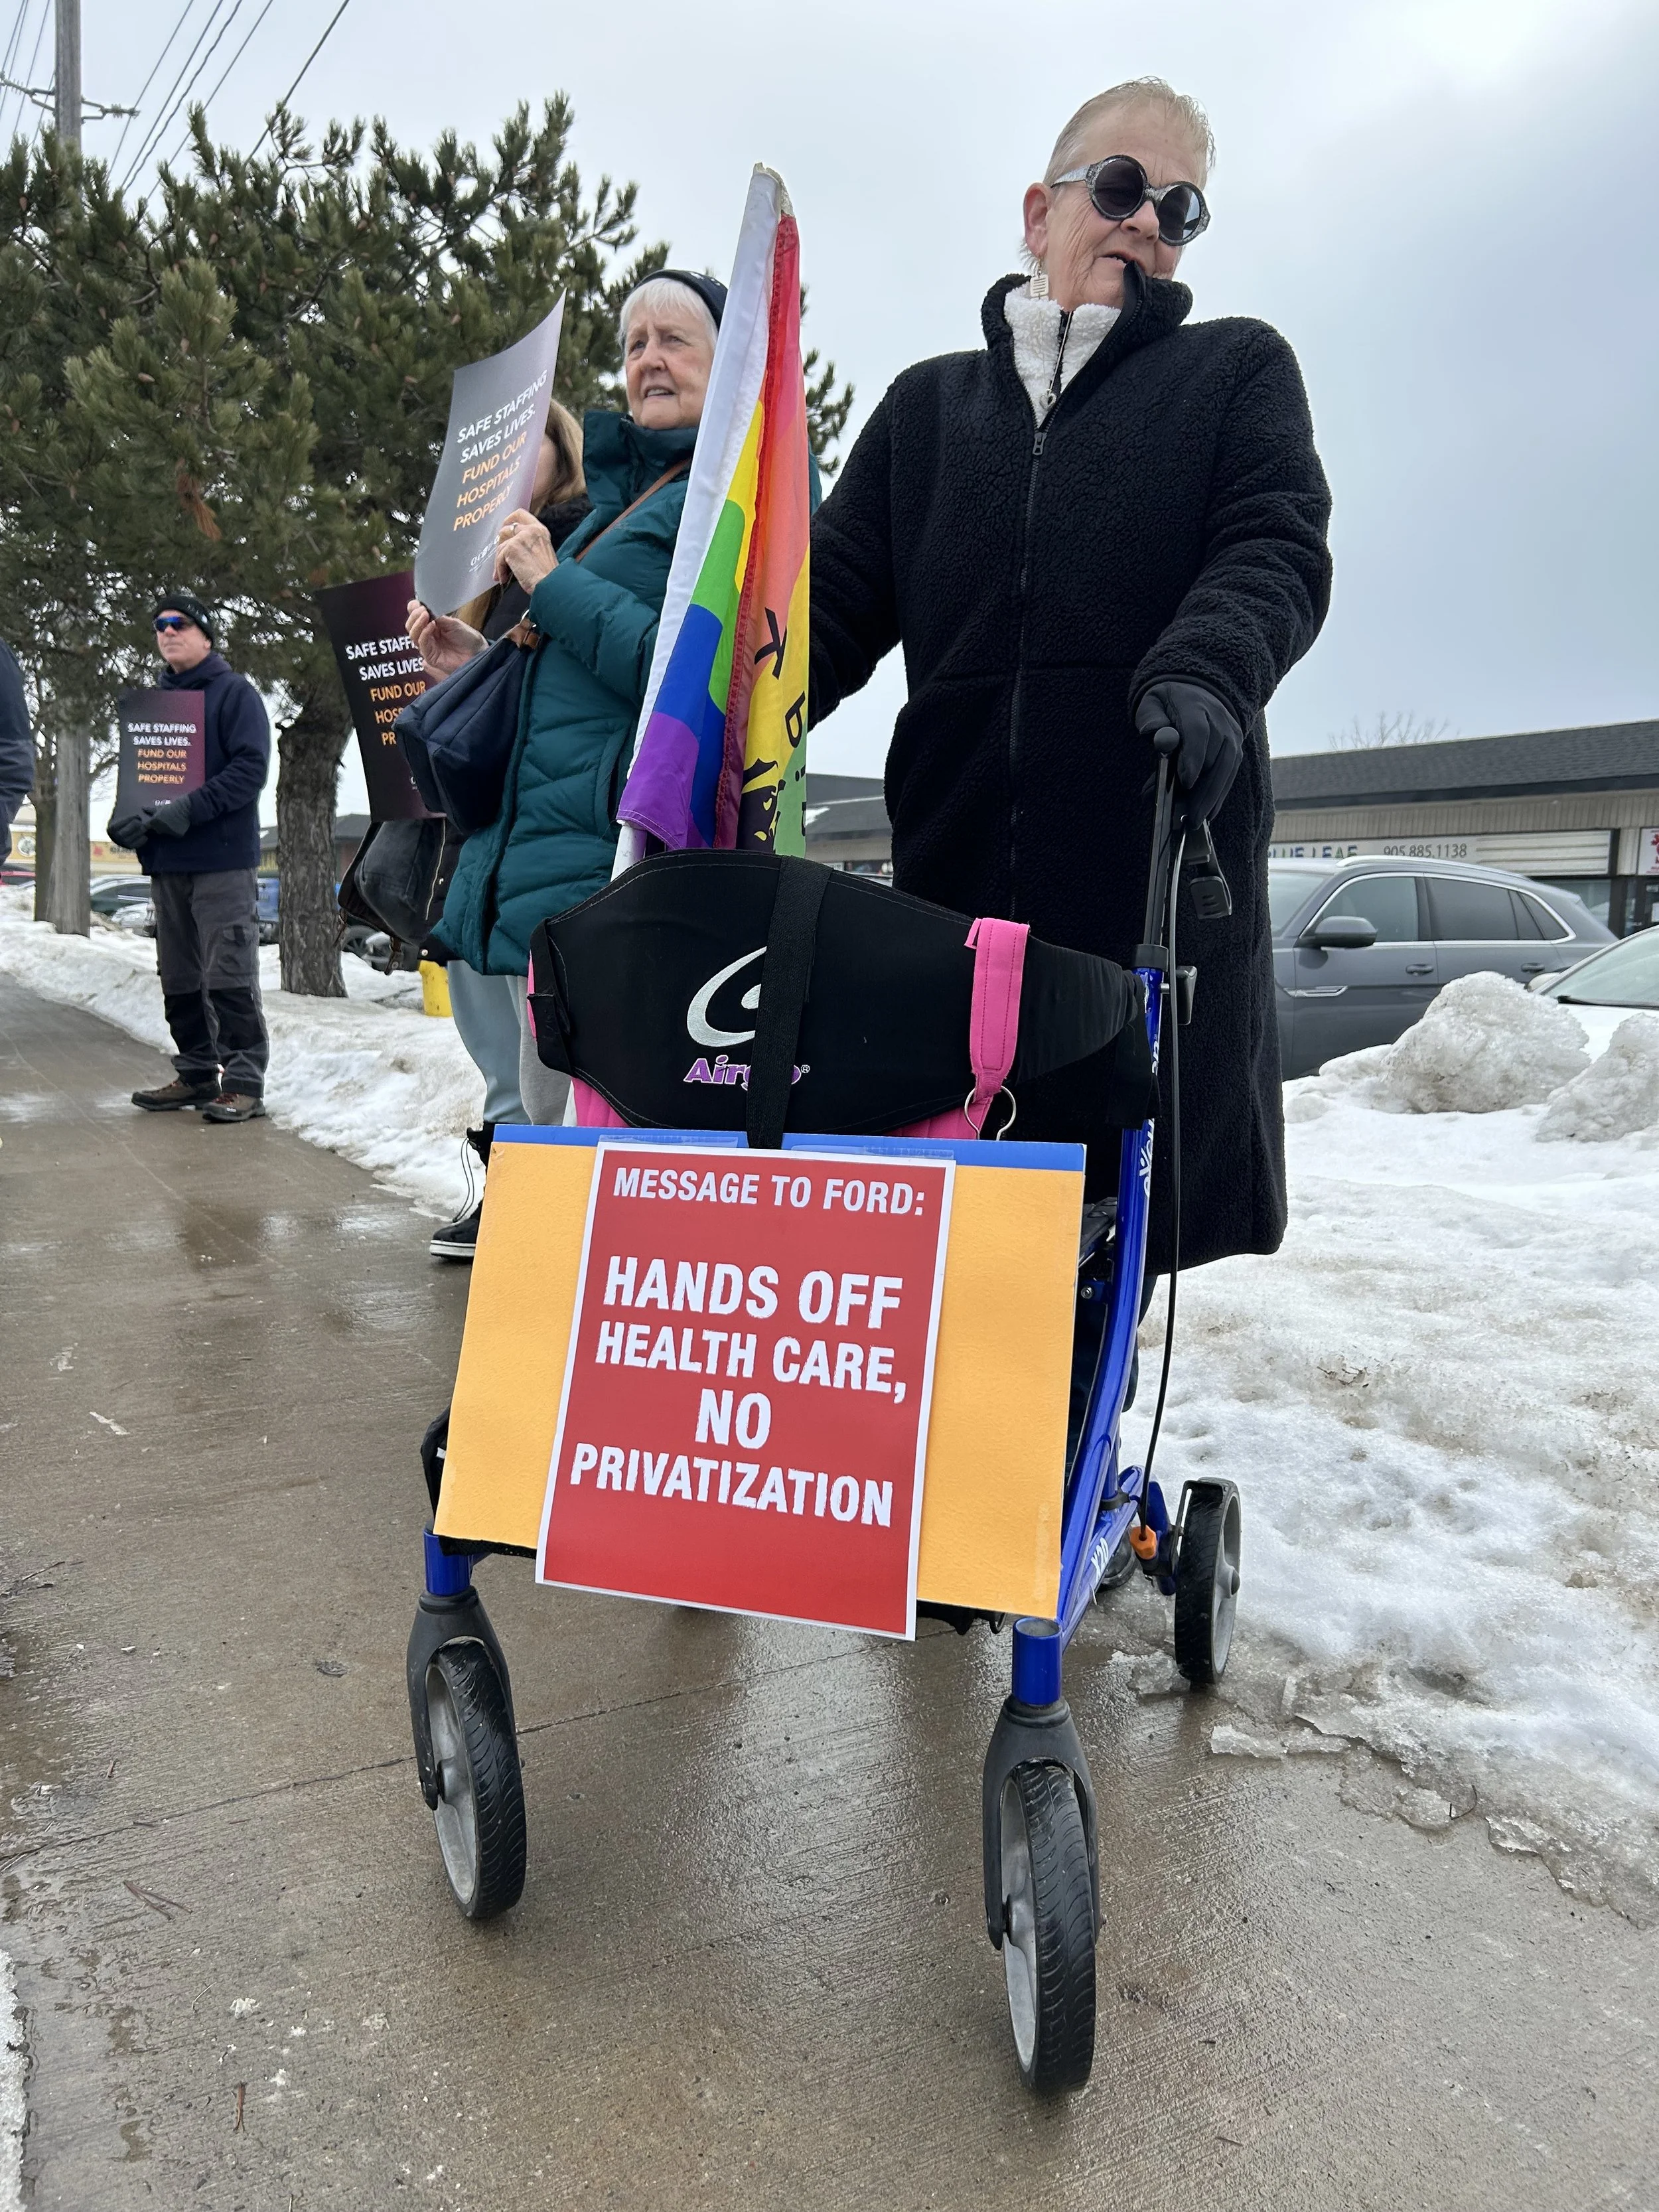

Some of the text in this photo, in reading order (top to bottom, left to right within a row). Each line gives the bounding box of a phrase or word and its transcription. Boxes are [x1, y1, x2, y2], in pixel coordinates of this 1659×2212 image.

[457, 369, 547, 443] SAFE STAFFING
[460, 403, 536, 463] SAVES LIVES.
[463, 431, 527, 484] FUND OUR
[453, 481, 514, 531] PROPERLY
[457, 455, 522, 508] HOSPITALS
[346, 641, 378, 660] SAFE
[359, 662, 396, 681] SAVES
[370, 680, 426, 702] FUND OUR
[127, 722, 197, 733] SAFE STAFFING
[133, 735, 192, 747] SAVES LIVES.
[137, 749, 187, 759] FUND OUR
[137, 761, 186, 772] HOSPITALS
[138, 774, 184, 784] PROPERLY
[614, 1168, 925, 1216] MESSAGE TO FORD:
[604, 1256, 902, 1329] HANDS OFF
[596, 1321, 906, 1404] HEALTH CARE,
[695, 1388, 770, 1449] NO
[571, 1443, 893, 1528] PRIVATIZATION
